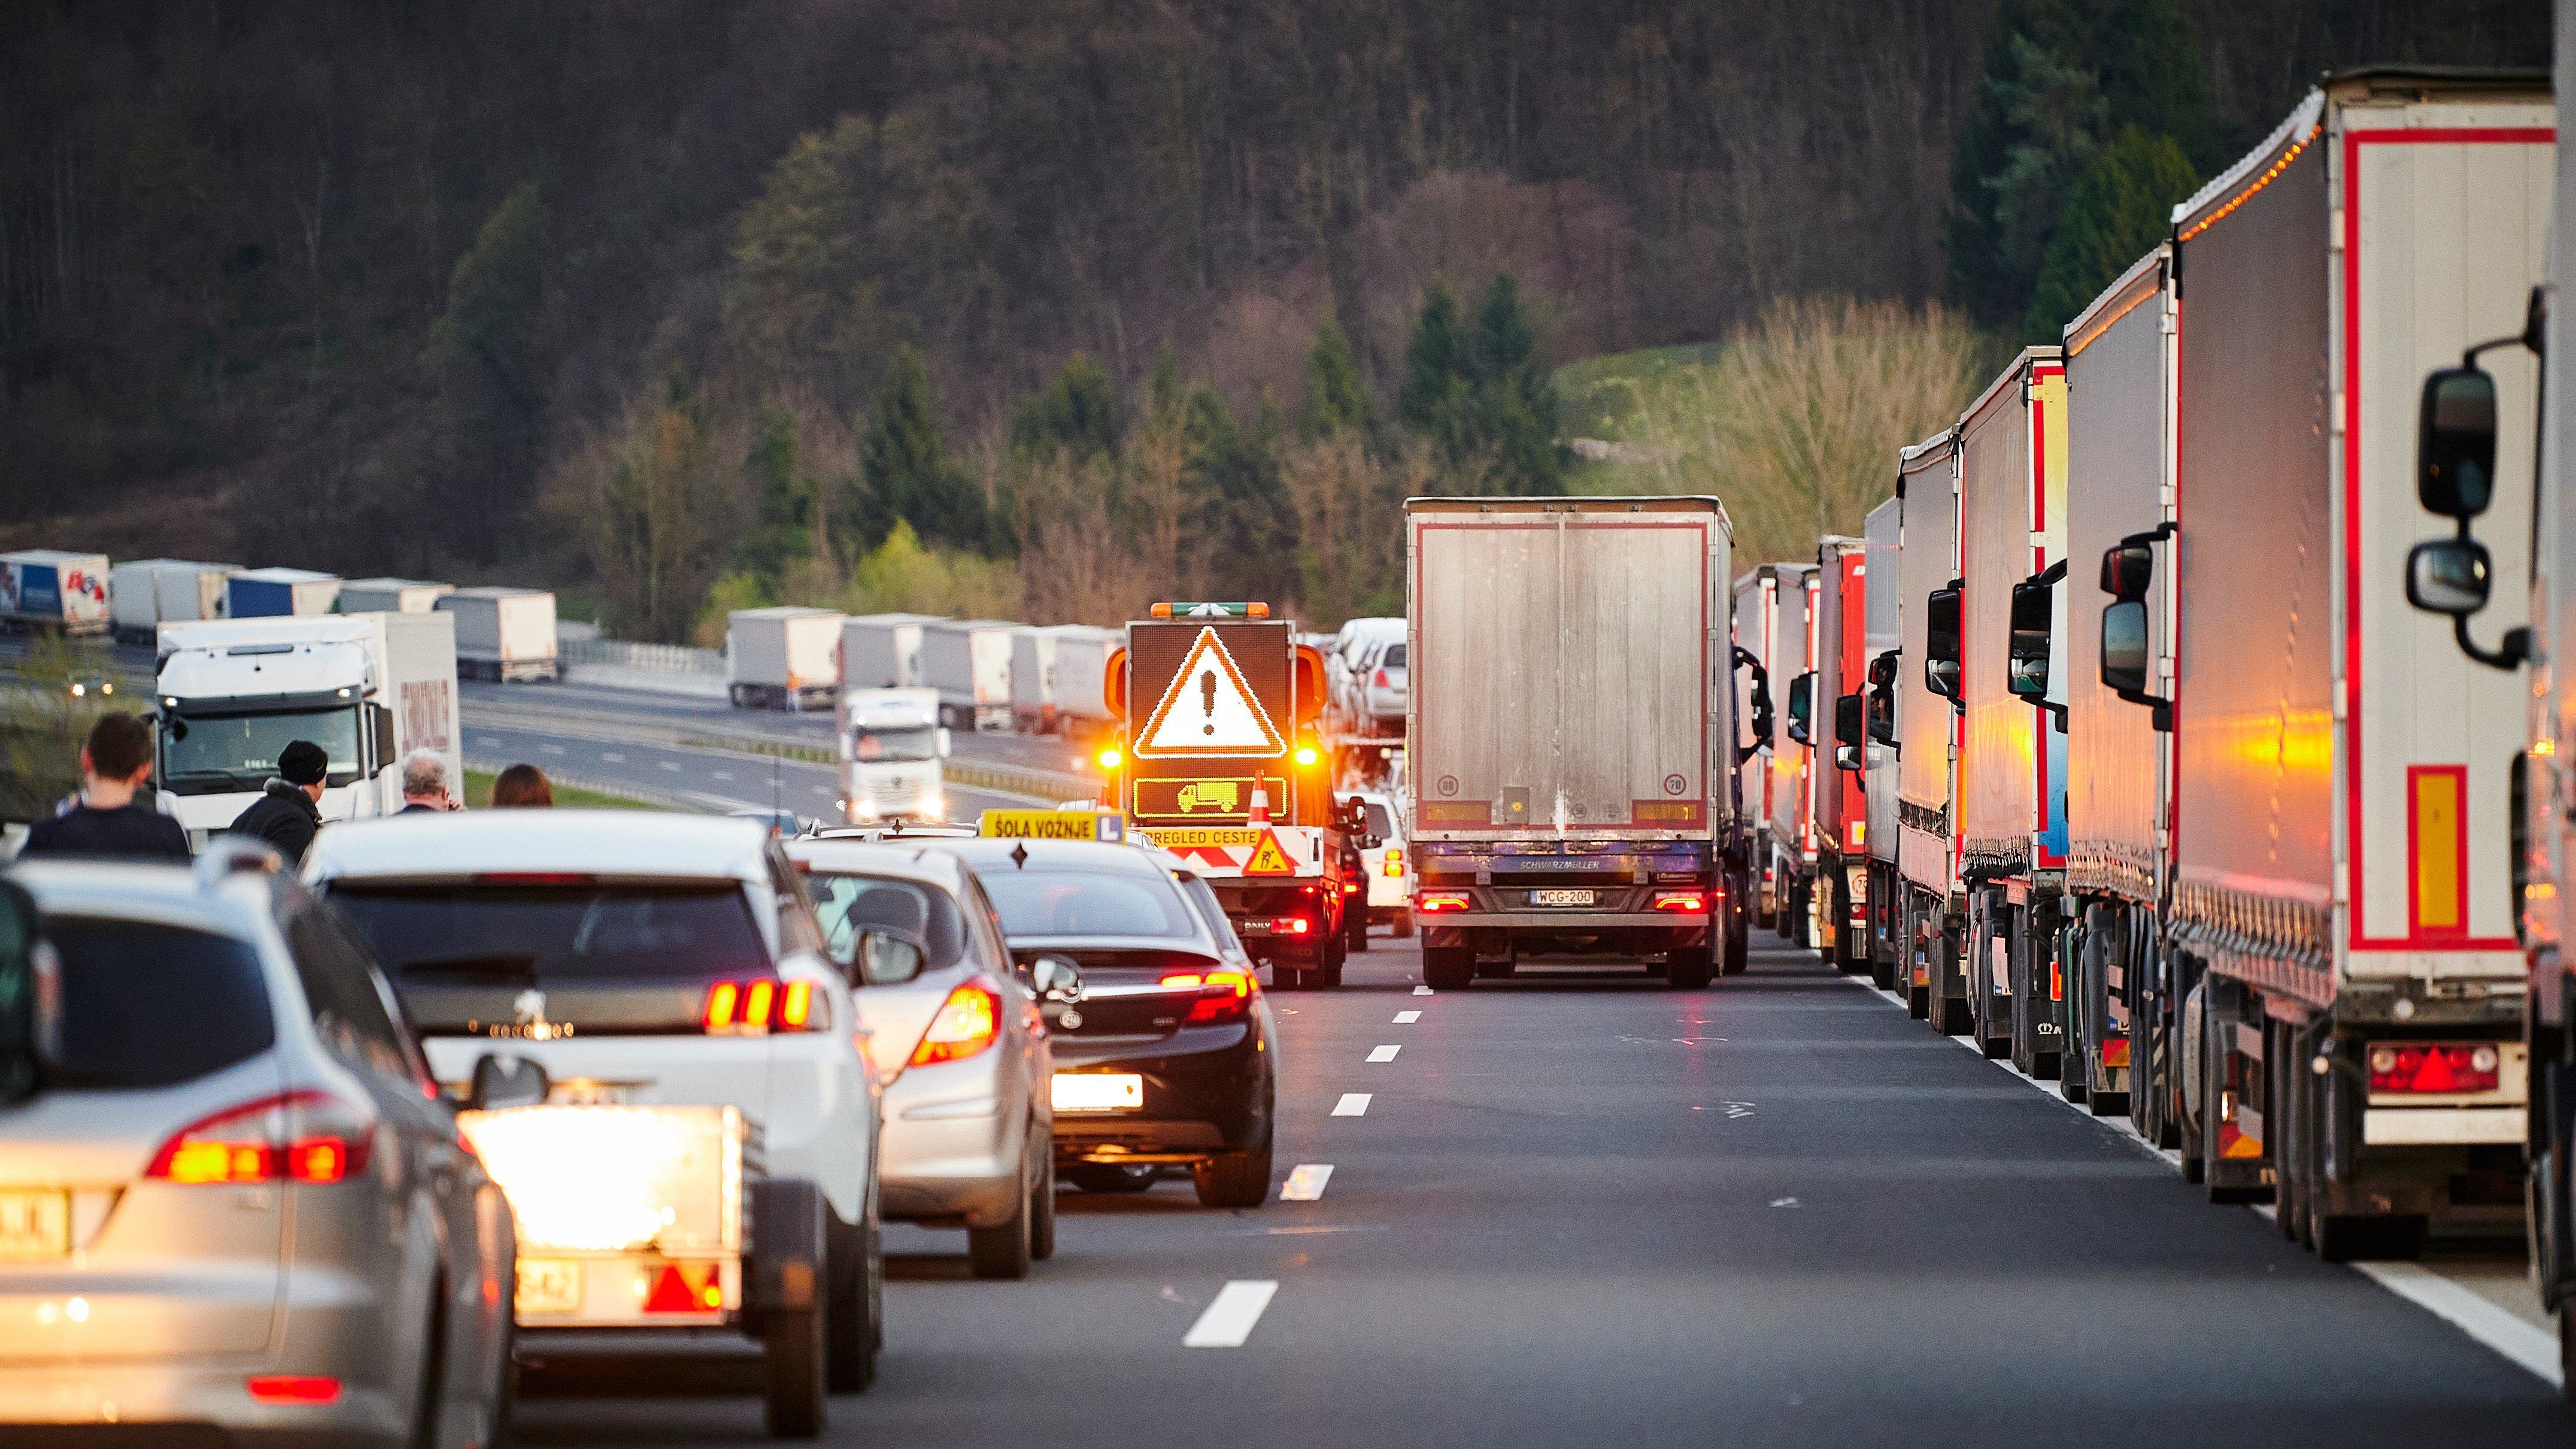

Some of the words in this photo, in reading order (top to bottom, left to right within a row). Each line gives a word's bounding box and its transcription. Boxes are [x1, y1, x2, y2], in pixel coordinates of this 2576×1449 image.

[1670, 780, 1681, 790] 70
[1101, 817, 1119, 841] L
[1213, 831, 1257, 843] CESTE
[1539, 891, 1591, 902] WCG-200
